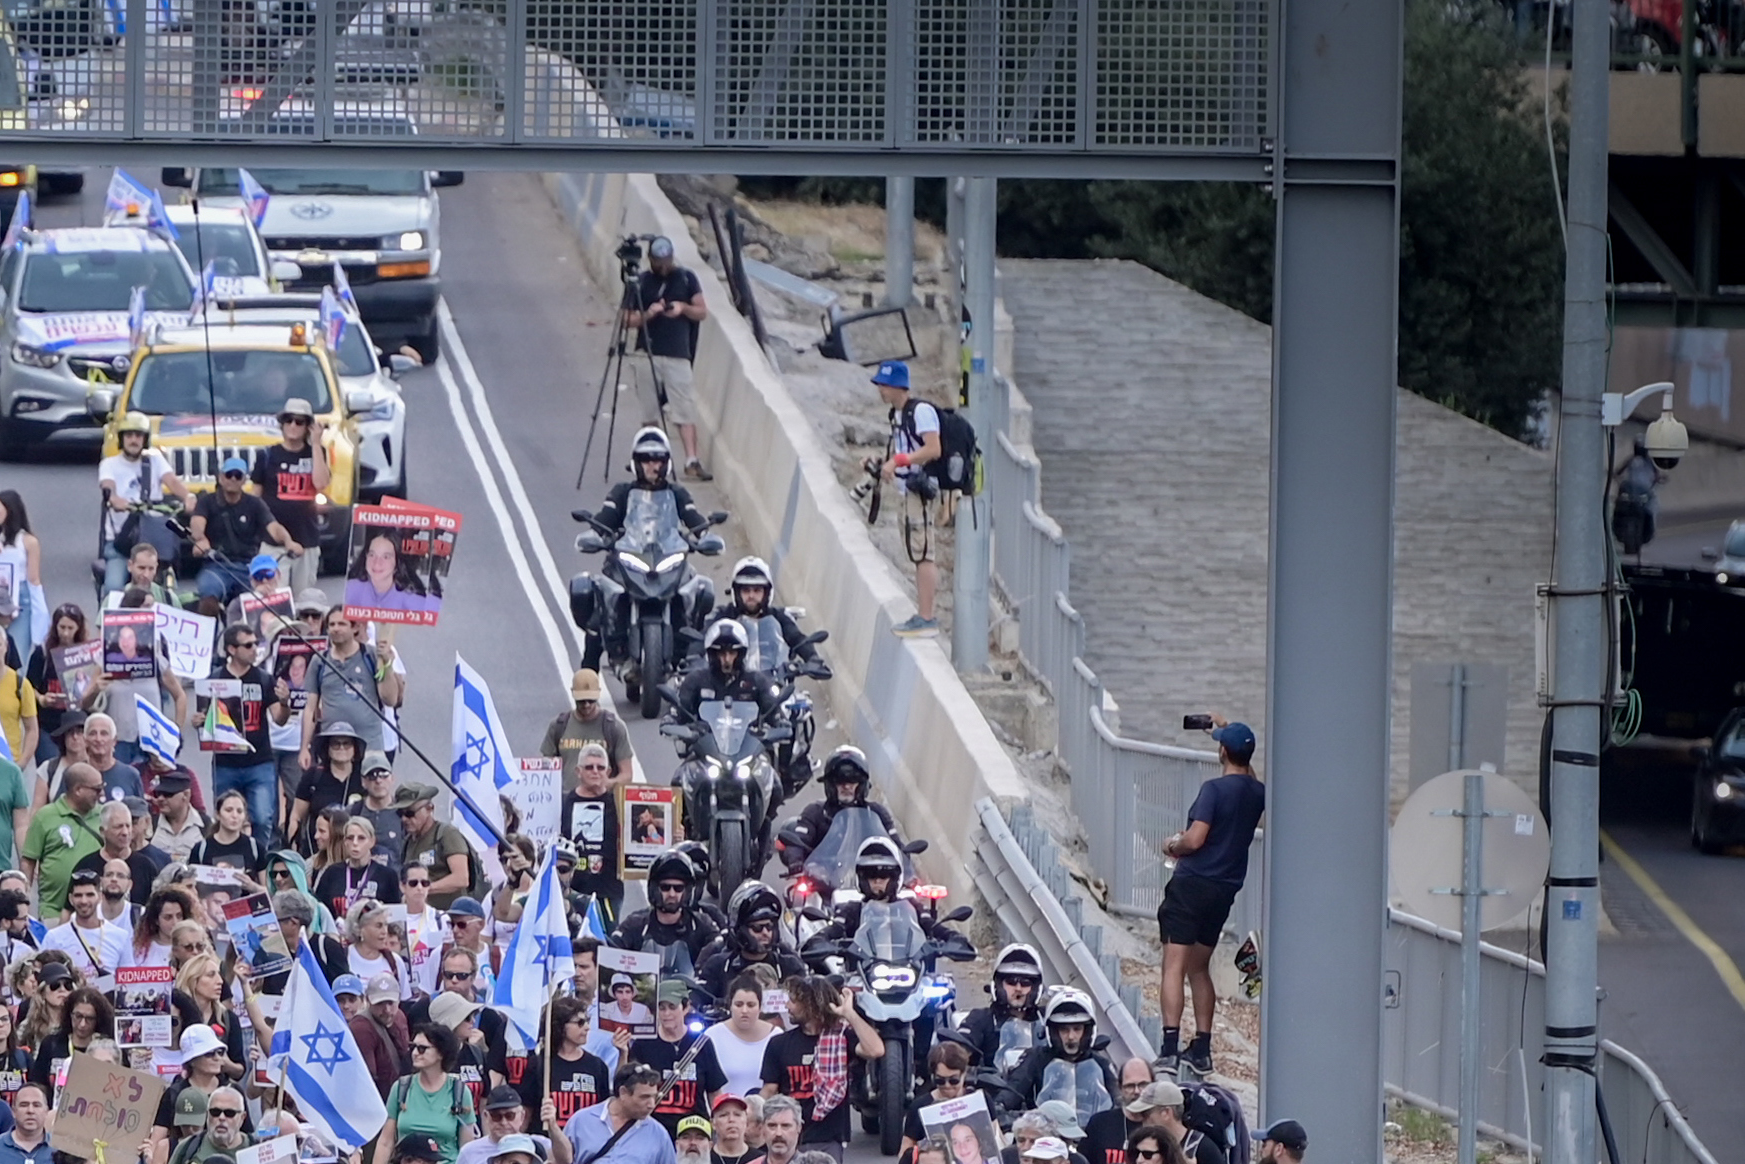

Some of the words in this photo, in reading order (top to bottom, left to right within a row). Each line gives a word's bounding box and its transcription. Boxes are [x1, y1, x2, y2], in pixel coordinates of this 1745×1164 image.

[358, 512, 430, 527] KIDNAPPED
[346, 607, 371, 619] בעזה
[373, 609, 405, 621] חטופה
[406, 611, 421, 622] גלי
[117, 969, 171, 983] KIDNAPPED
[103, 1072, 143, 1103] לא
[59, 1092, 141, 1135] סולחת!
